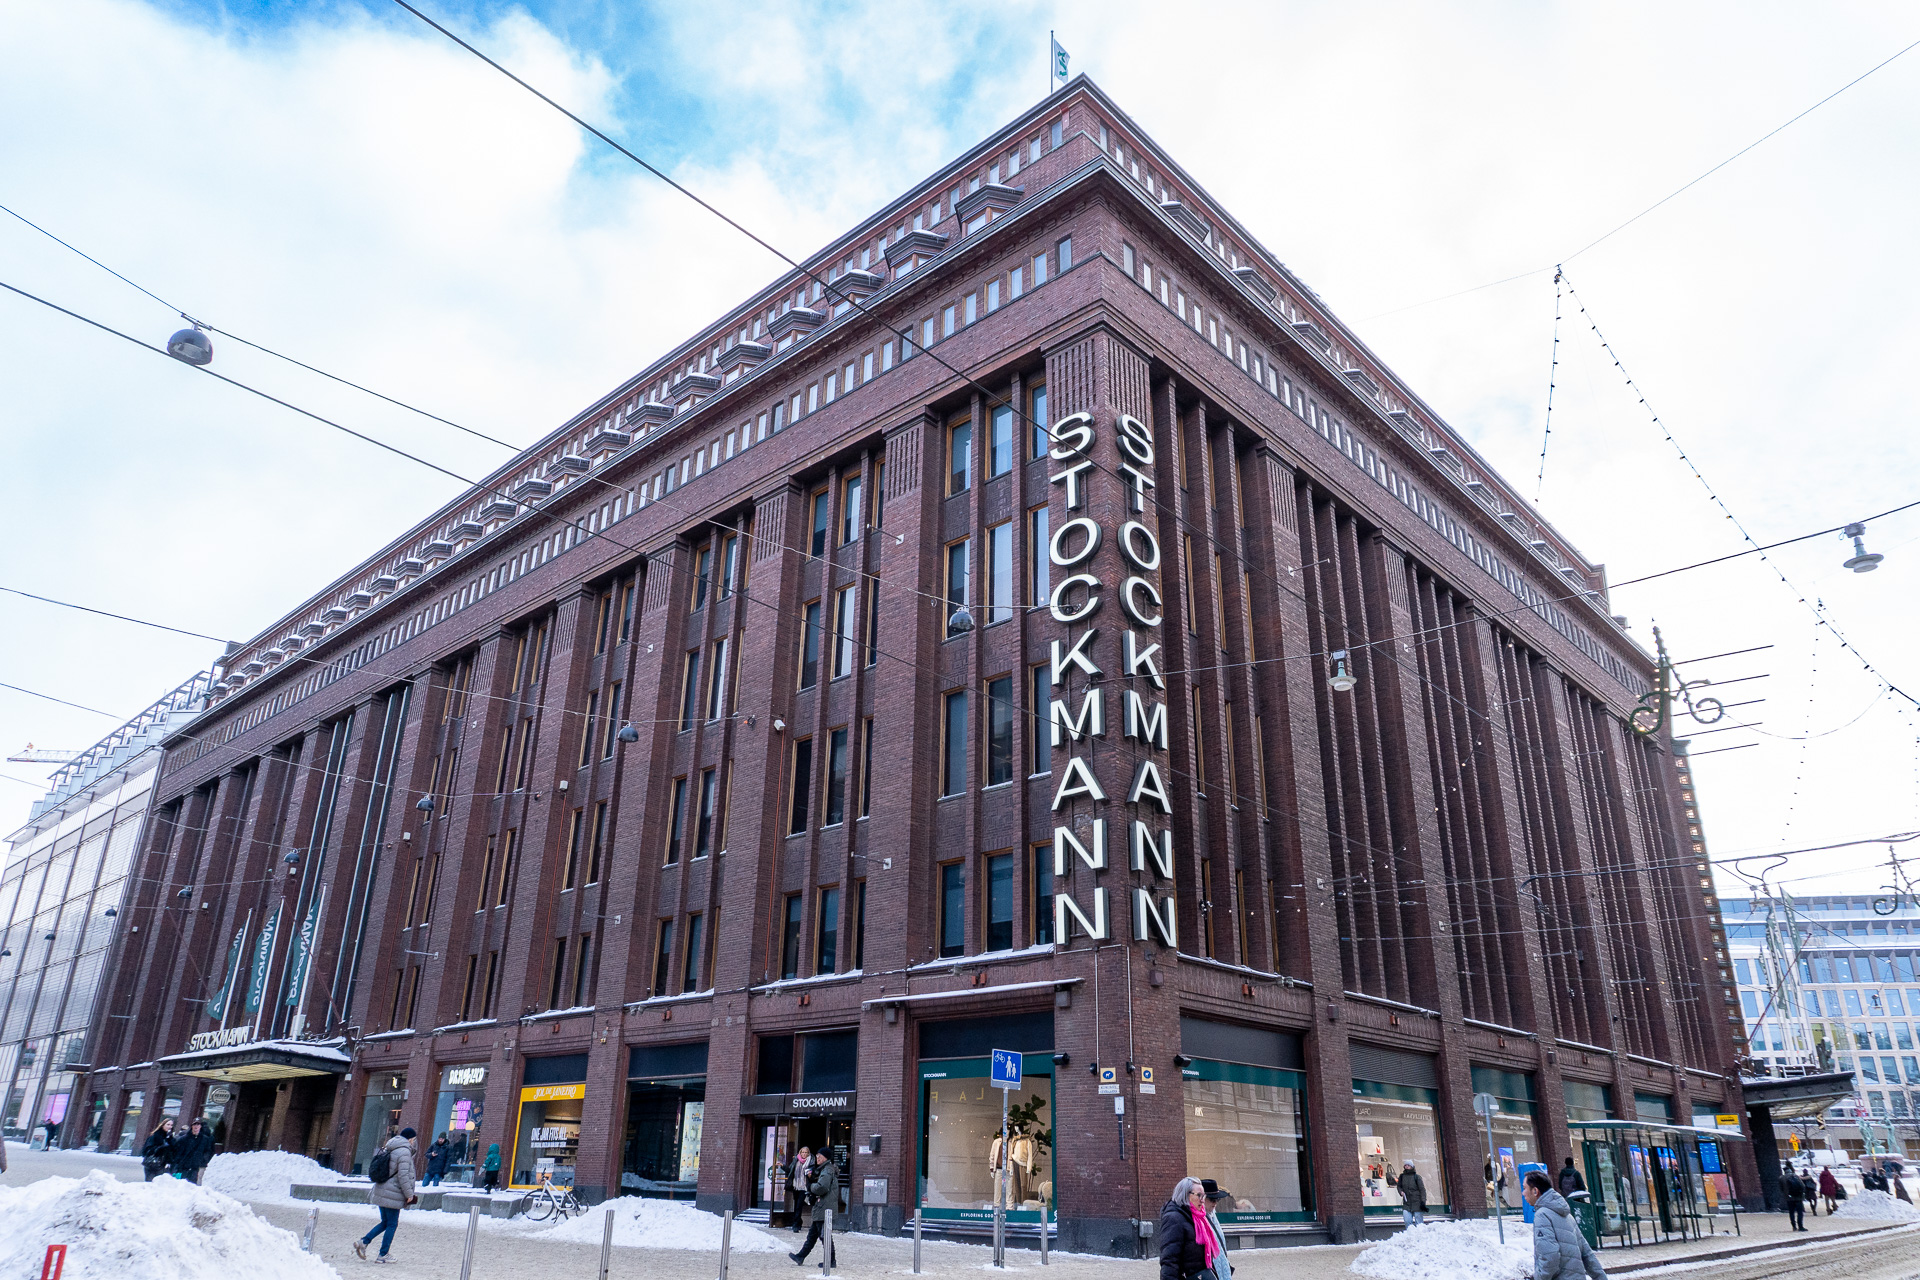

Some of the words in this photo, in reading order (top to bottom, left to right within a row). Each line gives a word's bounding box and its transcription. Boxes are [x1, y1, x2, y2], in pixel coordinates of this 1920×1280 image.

[1049, 411, 1109, 946] STOCKMANN
[1116, 414, 1177, 949] STOCKMANN
[190, 1025, 250, 1051] STOCKMANN
[550, 1086, 576, 1099] JANEIRO
[792, 1097, 847, 1108] STOCKMANN
